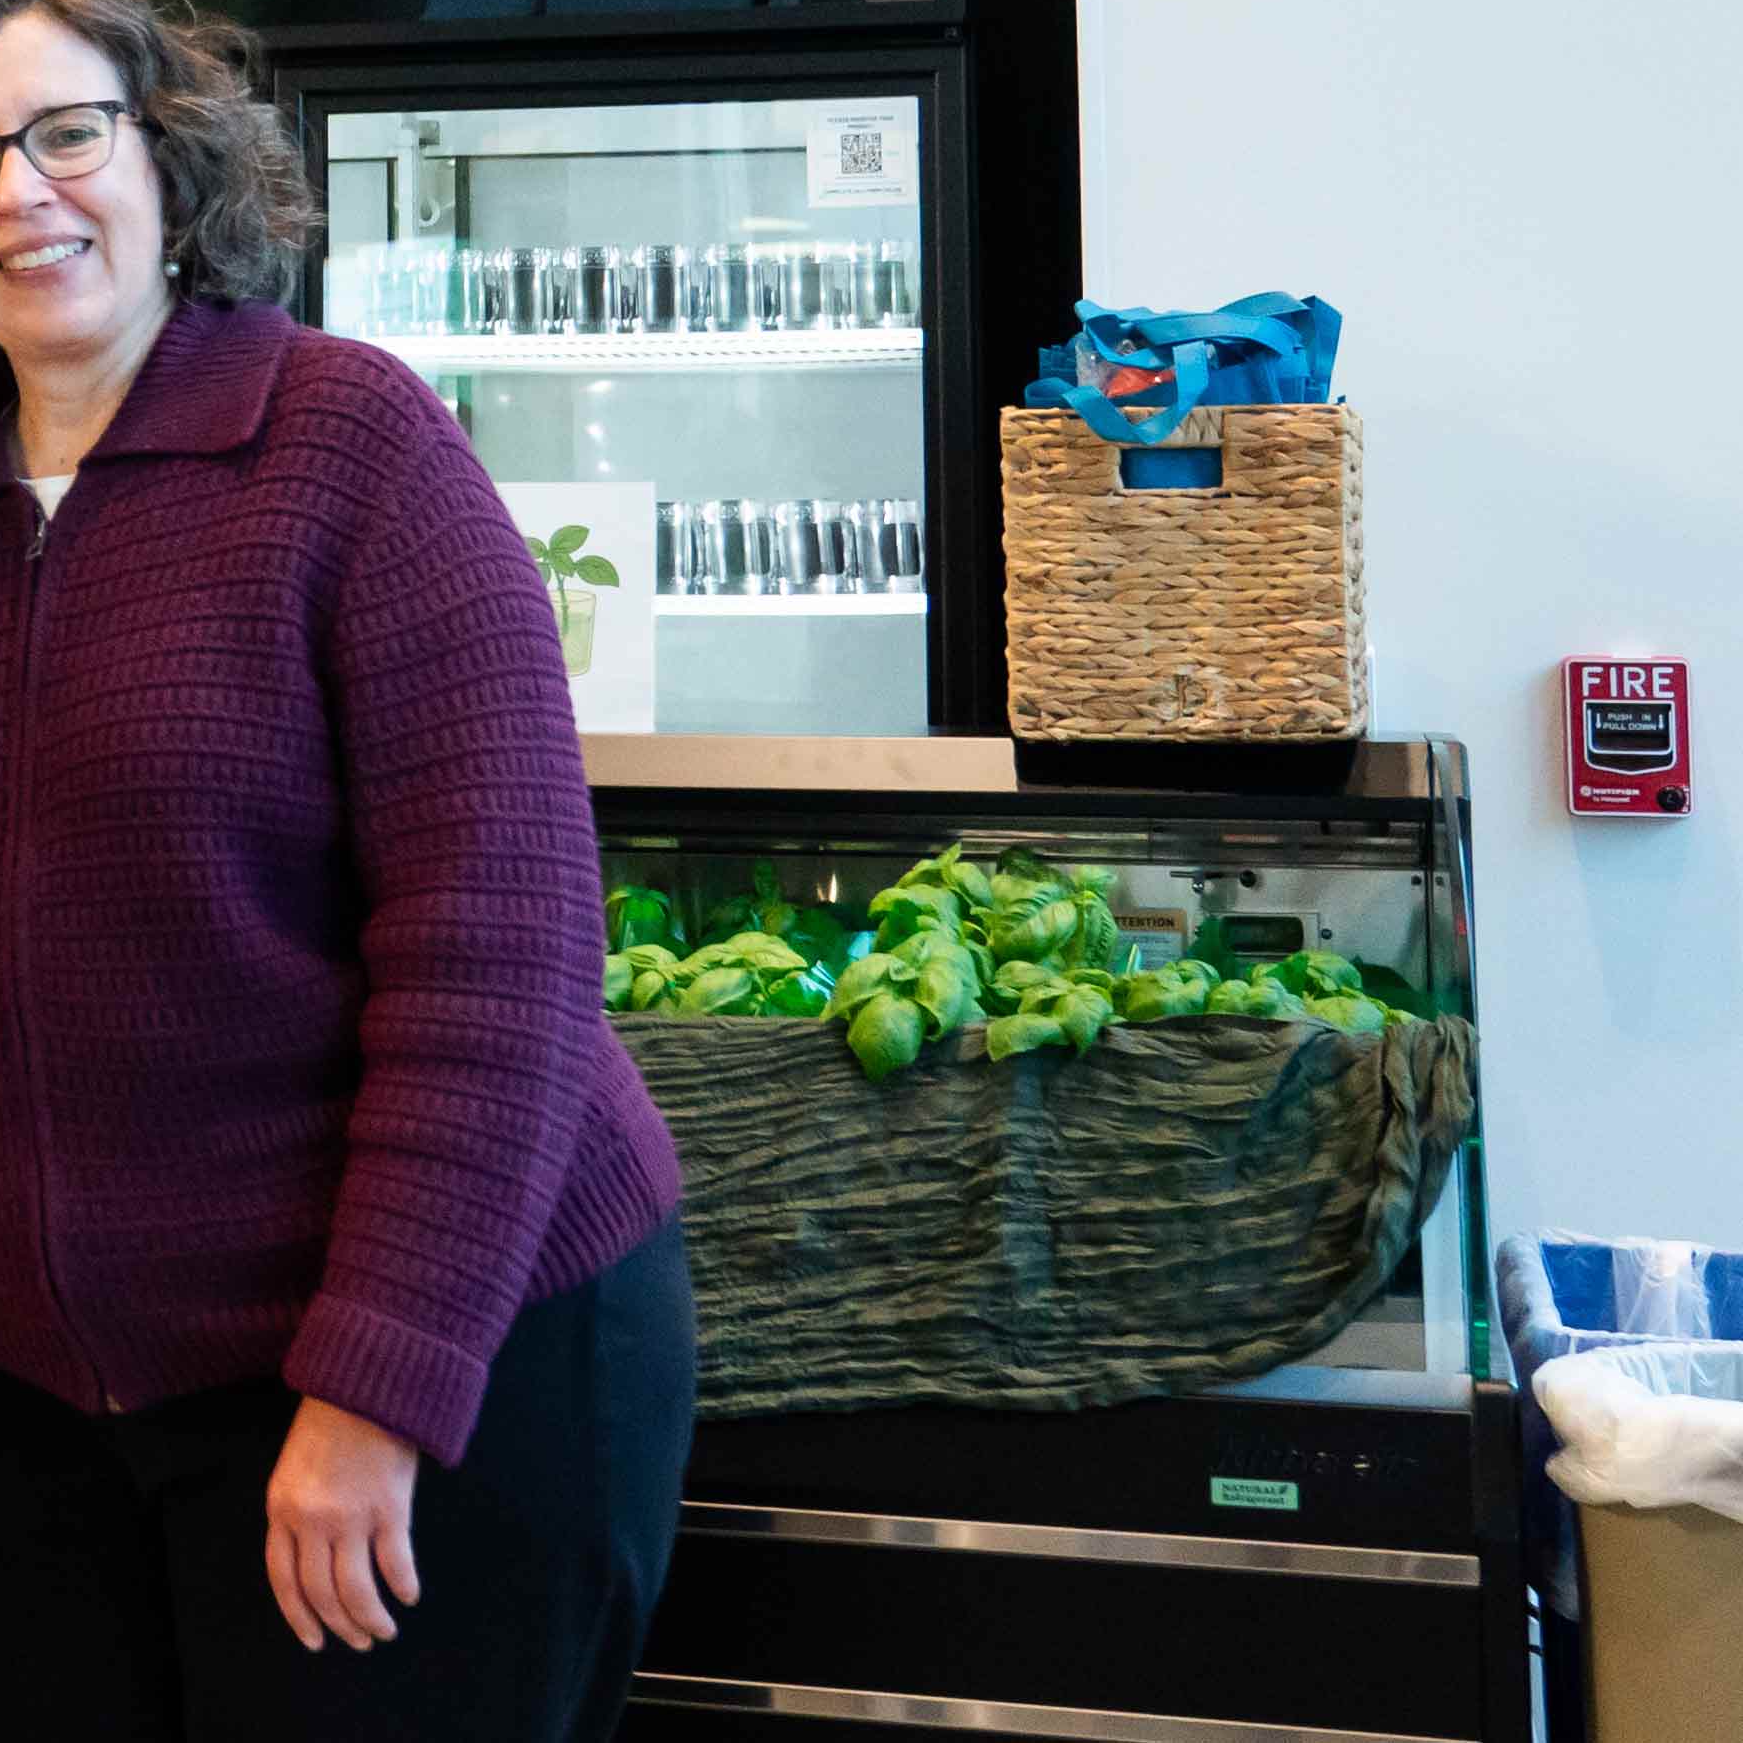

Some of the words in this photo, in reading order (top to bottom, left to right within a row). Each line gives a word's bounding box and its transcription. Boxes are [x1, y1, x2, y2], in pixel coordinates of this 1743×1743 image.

[1581, 666, 1676, 699] FIRE
[1607, 713, 1633, 721] PUSH
[1641, 713, 1652, 721] IN
[1602, 722, 1626, 730] PULL
[1628, 722, 1657, 731] DOWN
